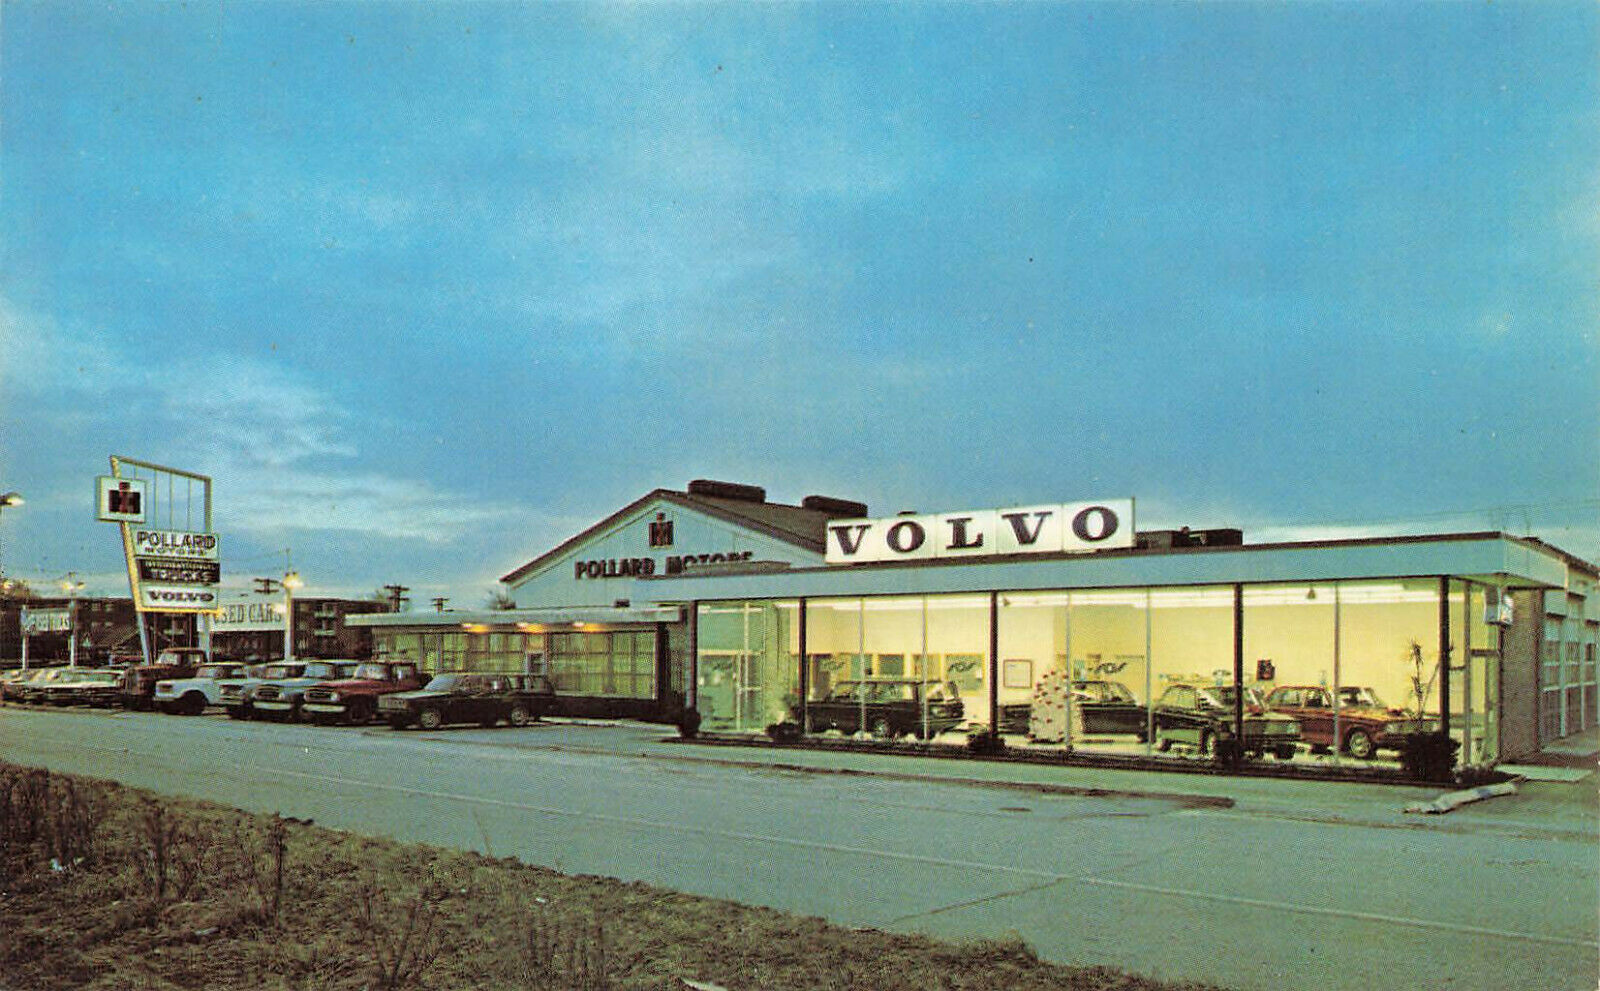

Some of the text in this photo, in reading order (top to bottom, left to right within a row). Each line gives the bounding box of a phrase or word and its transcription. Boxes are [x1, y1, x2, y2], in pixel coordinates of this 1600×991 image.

[137, 531, 216, 549] POLLARD
[828, 506, 1119, 555] VOLVO
[575, 557, 656, 579] POLLARD
[147, 590, 215, 602] VOLVO
